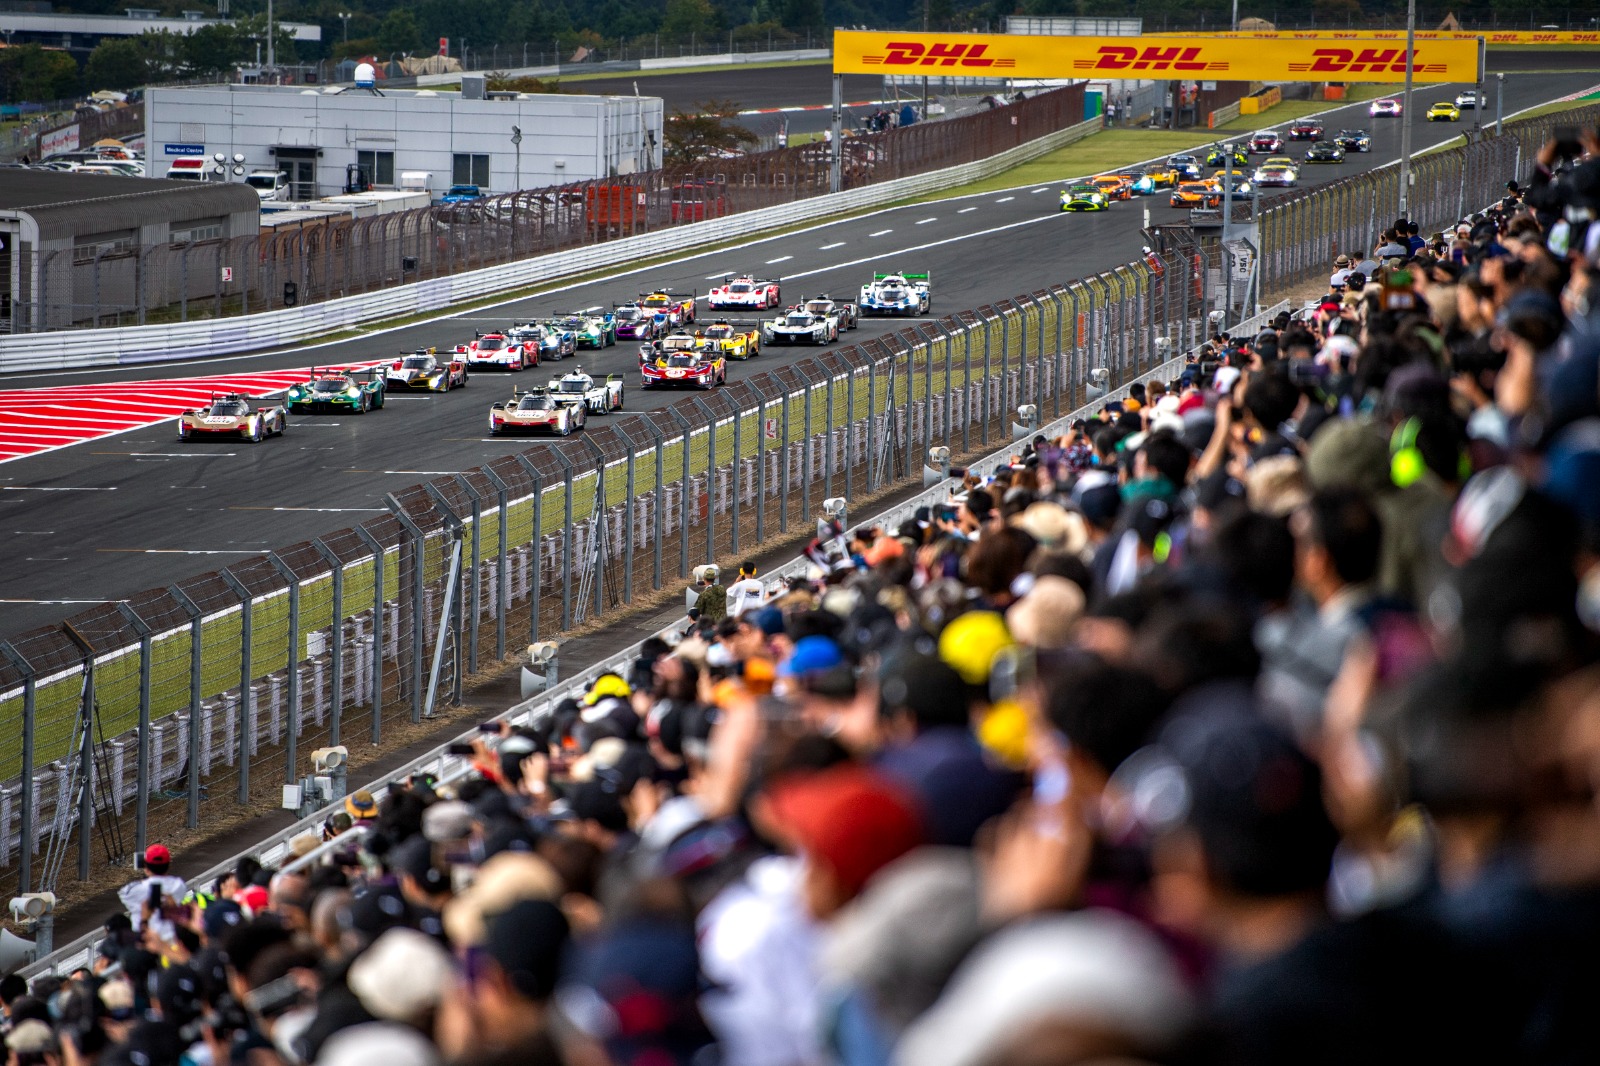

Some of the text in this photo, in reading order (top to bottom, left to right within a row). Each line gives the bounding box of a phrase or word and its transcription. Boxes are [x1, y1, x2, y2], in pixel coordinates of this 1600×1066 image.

[883, 42, 994, 66] DHL
[1095, 46, 1208, 70] DHL
[1310, 49, 1425, 72] DHL
